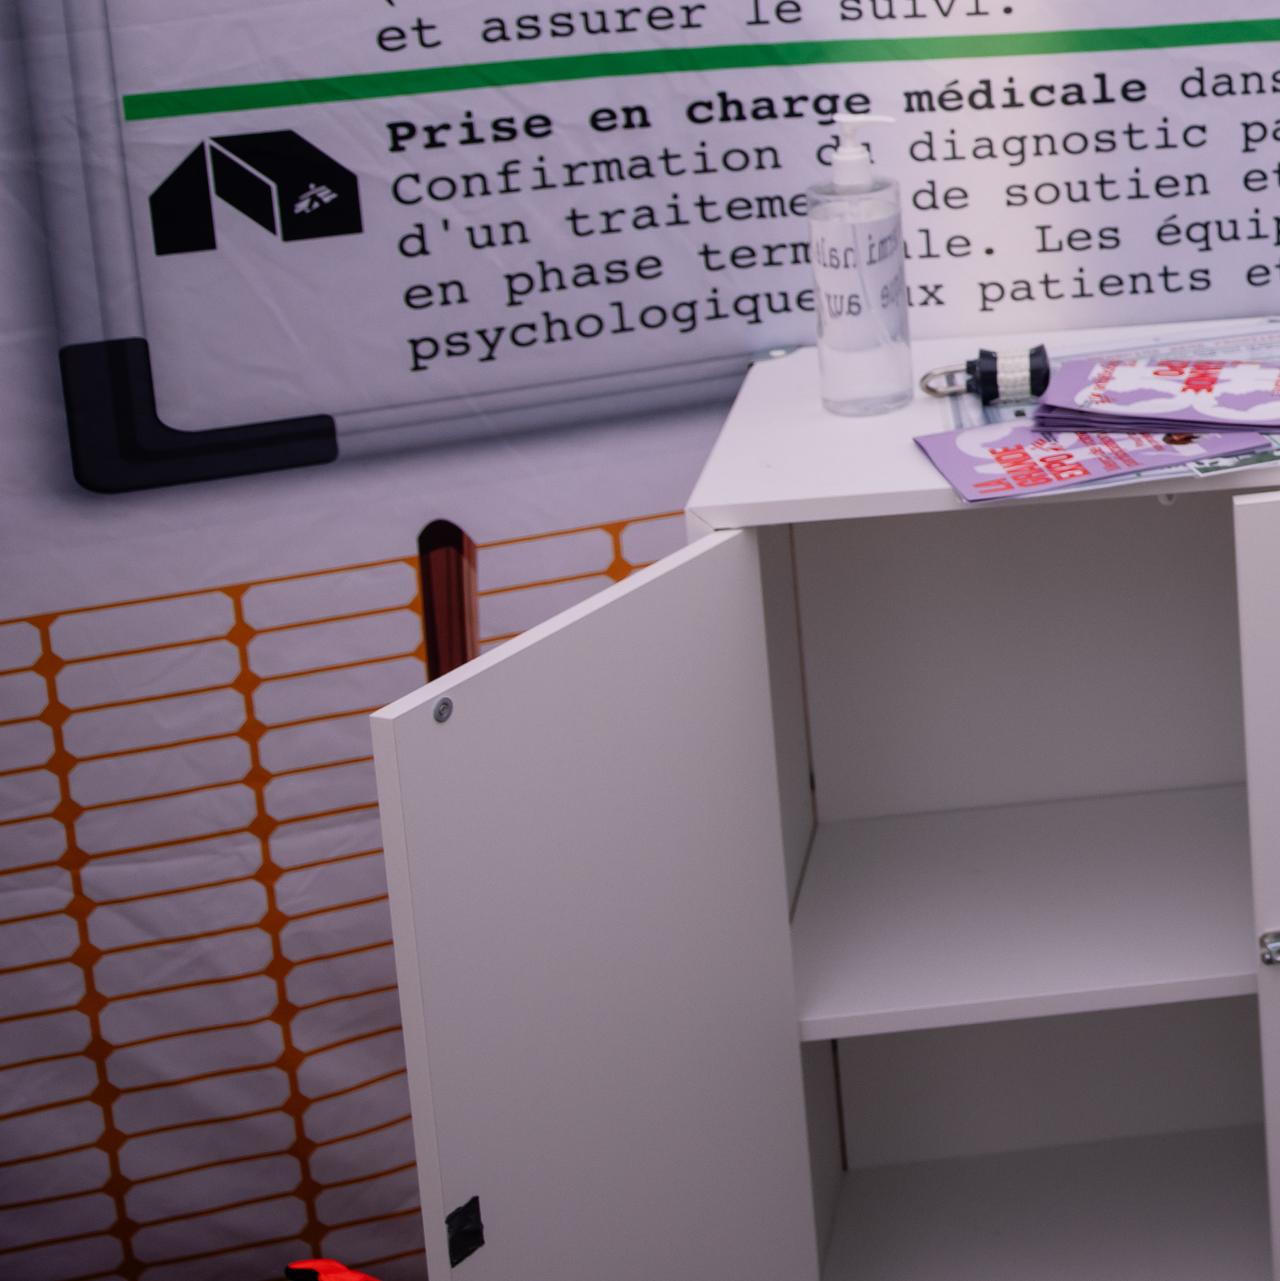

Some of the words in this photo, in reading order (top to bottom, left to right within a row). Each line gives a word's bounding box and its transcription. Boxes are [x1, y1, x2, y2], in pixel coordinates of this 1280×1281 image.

[376, 18, 441, 52] et
[482, 4, 706, 43] assurer
[386, 111, 553, 153] Prise
[589, 105, 651, 132] en
[686, 91, 870, 126] charge
[904, 73, 1146, 113] médicale
[392, 141, 782, 205] Confirmation
[910, 117, 1206, 166] diagnostic
[398, 219, 530, 258] d'un
[565, 193, 808, 237] traiteme
[913, 180, 968, 210] de
[1006, 167, 1210, 206] soutien
[404, 280, 469, 310] en
[504, 256, 662, 307] phase
[1036, 226, 1120, 252] Les
[408, 288, 815, 372] psychologique
[979, 266, 1211, 311] patients
